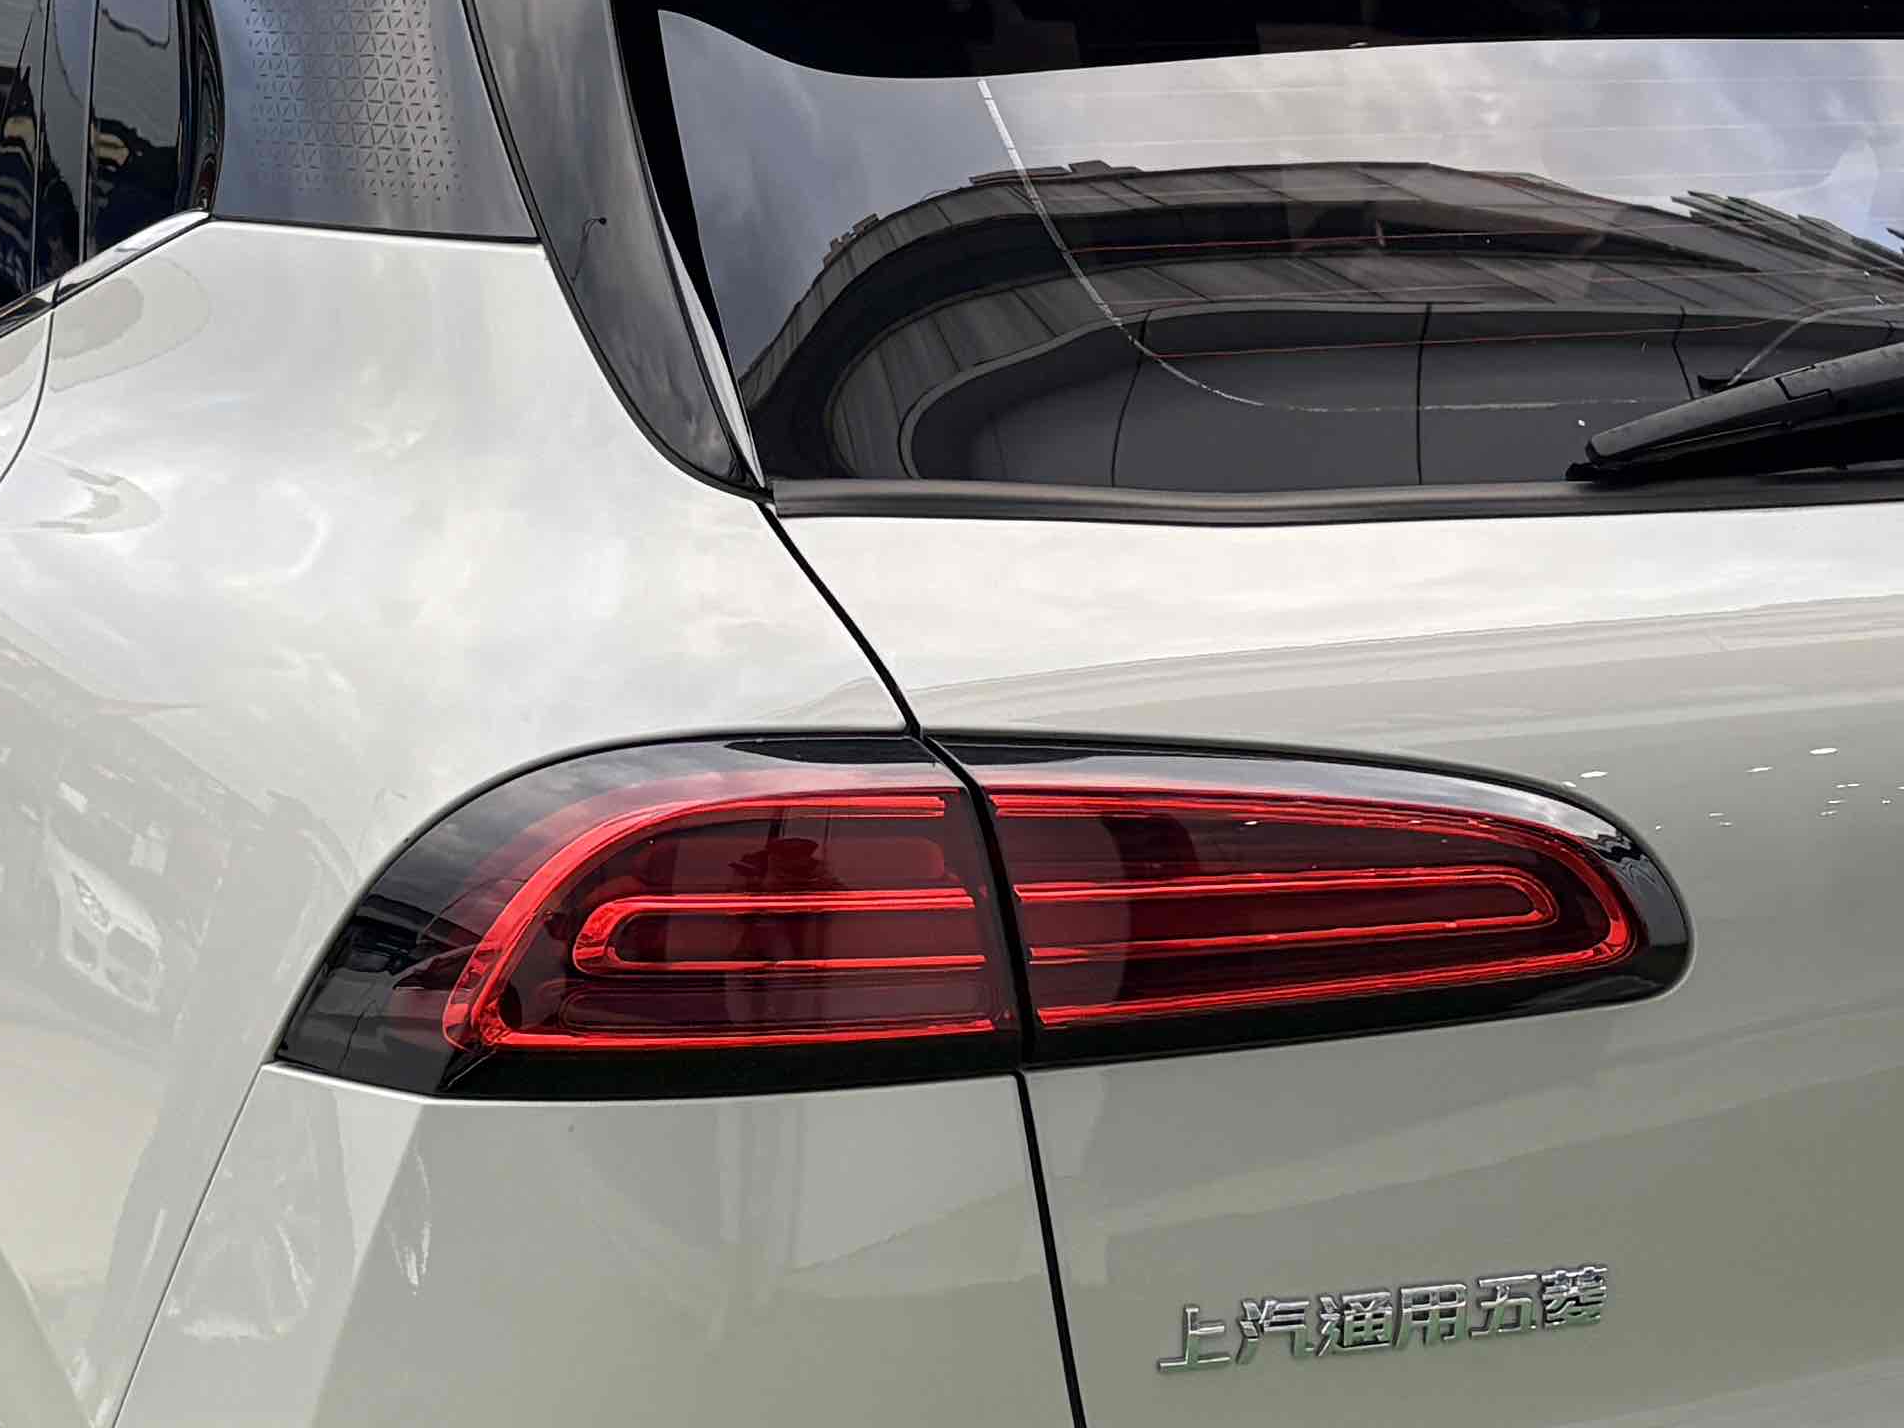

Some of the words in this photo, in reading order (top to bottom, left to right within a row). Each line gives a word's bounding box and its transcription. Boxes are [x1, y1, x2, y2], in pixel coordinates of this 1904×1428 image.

[1157, 1265, 1609, 1372] 上汽通用五菱
